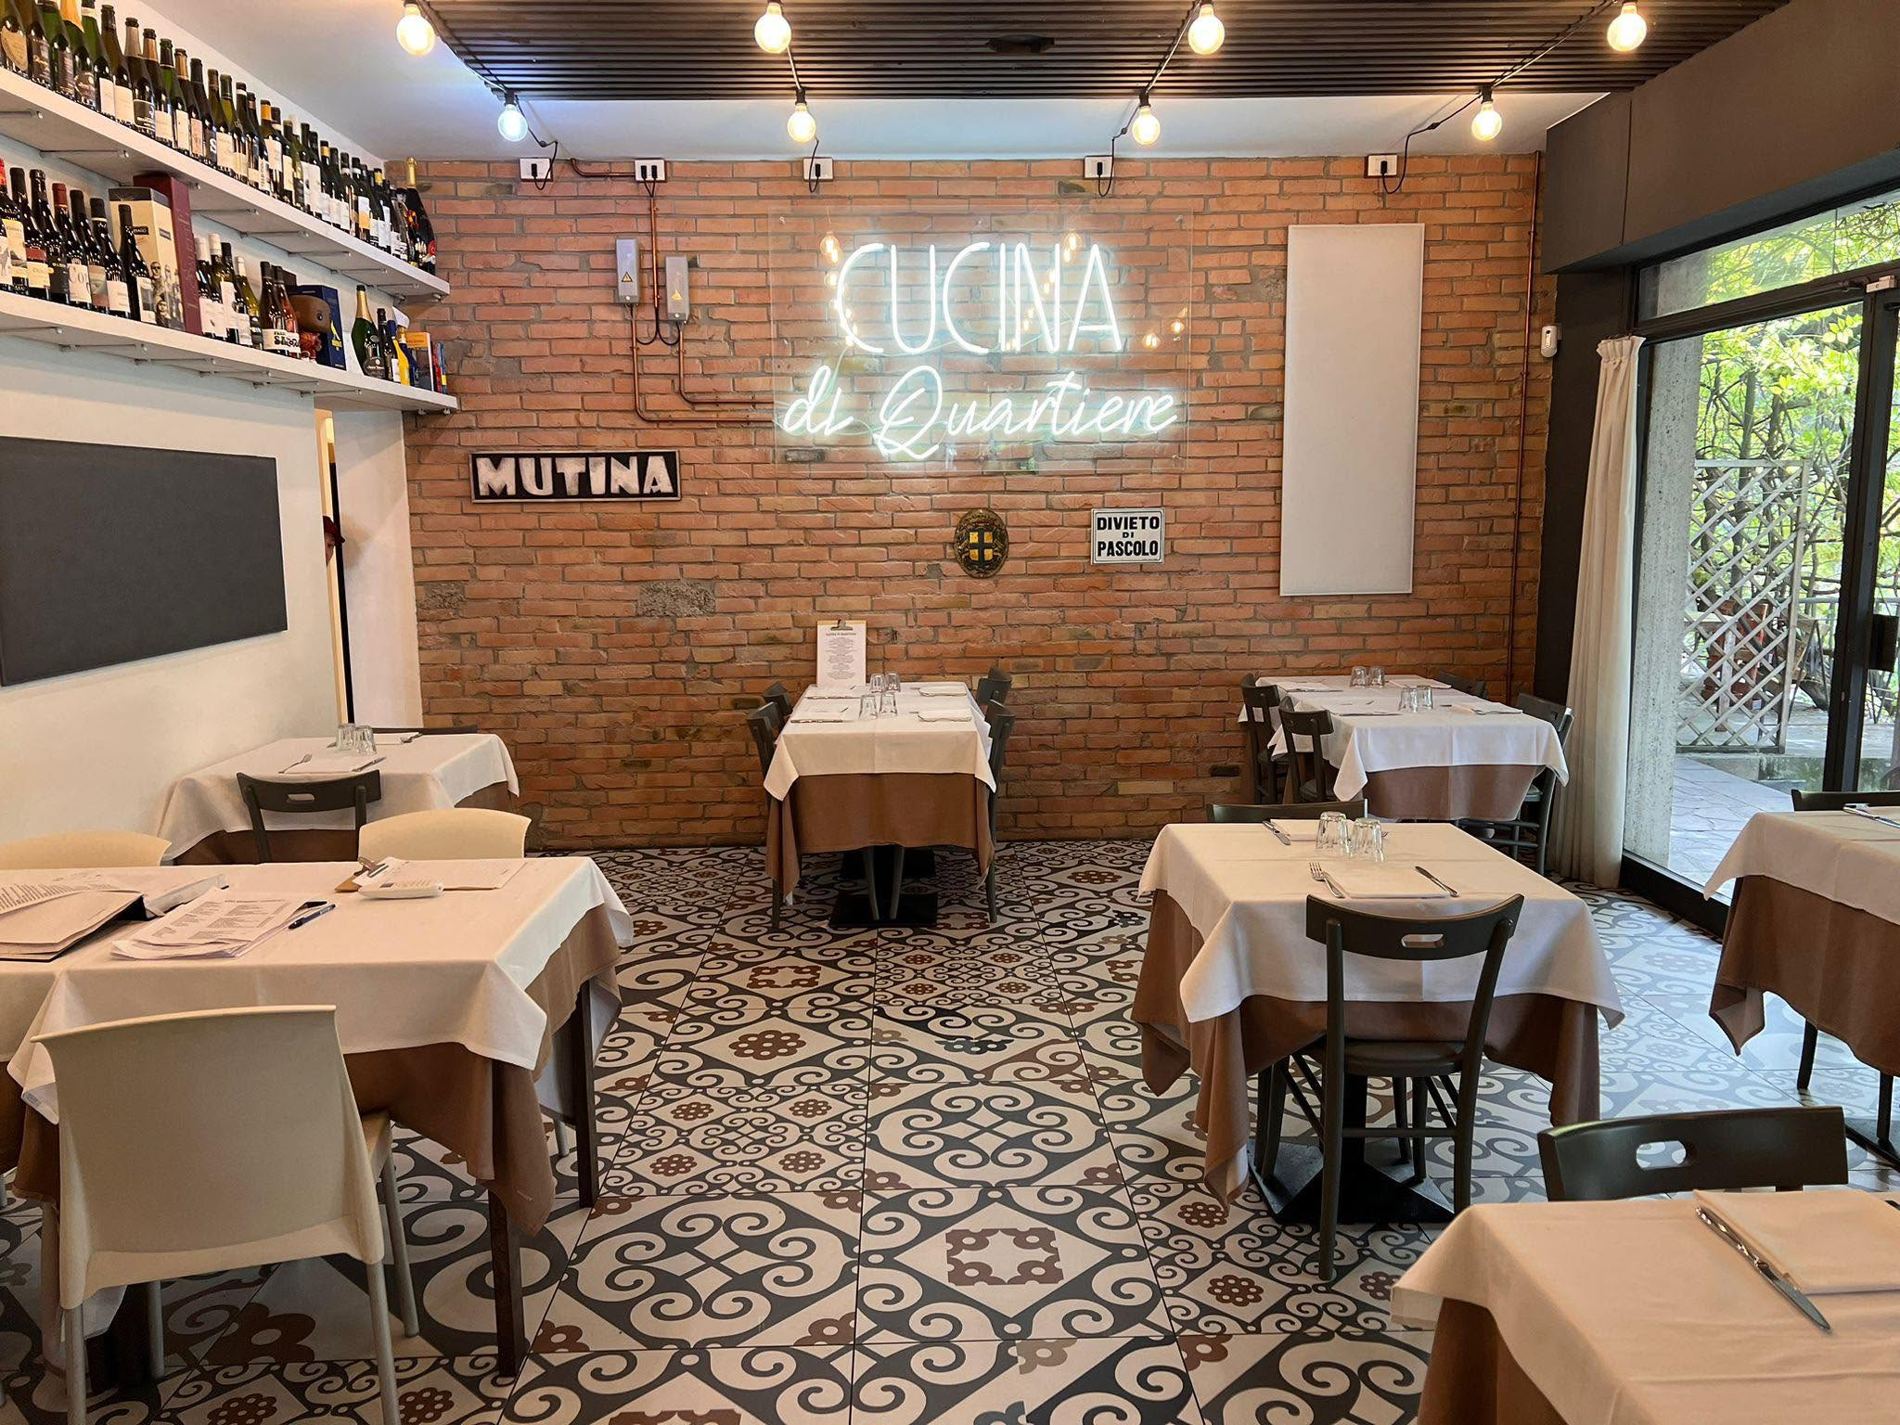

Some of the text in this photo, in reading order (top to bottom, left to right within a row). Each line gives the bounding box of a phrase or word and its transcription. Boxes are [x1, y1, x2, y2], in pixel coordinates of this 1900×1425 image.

[836, 242, 1123, 354] CUCINA
[783, 365, 1178, 460] di Quartiere
[476, 455, 674, 496] MUTINA
[1097, 516, 1160, 530] DIVIETO
[1097, 540, 1159, 556] PASCOLO
